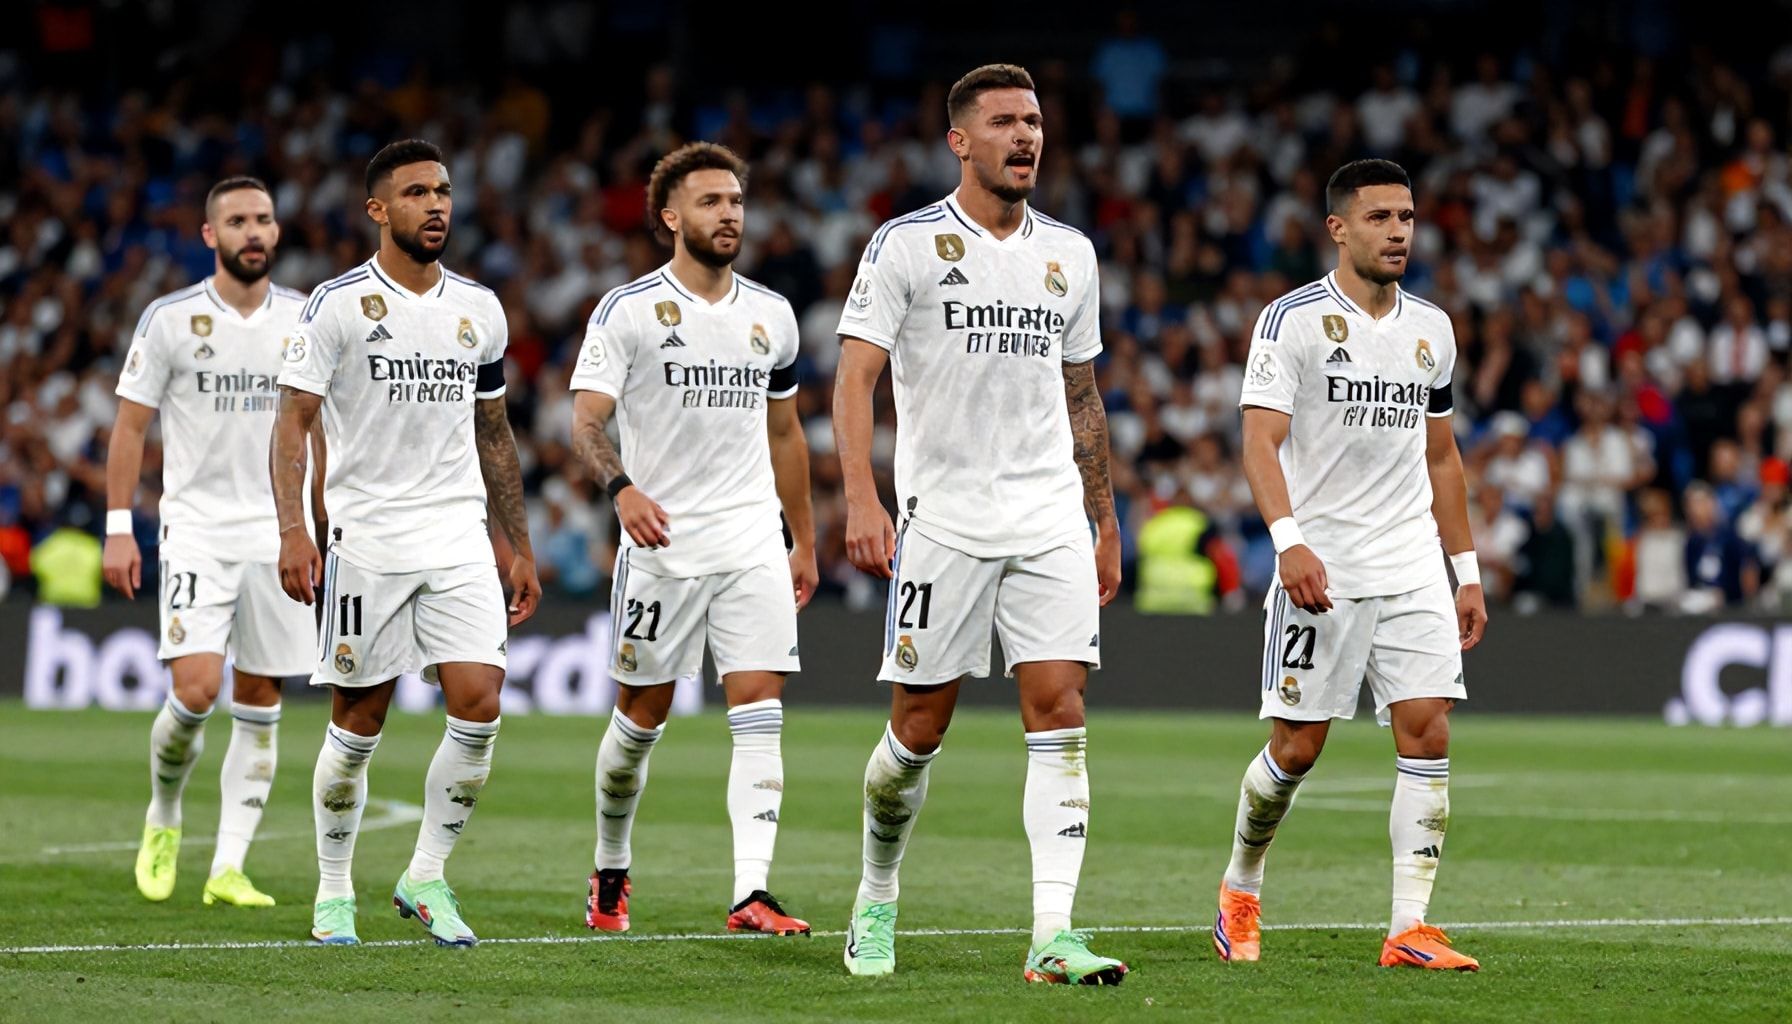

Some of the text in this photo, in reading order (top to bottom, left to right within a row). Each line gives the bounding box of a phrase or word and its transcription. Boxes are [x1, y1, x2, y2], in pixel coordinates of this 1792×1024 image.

[340, 594, 362, 637] 11
[624, 598, 661, 642] 21
[898, 580, 933, 629] 21
